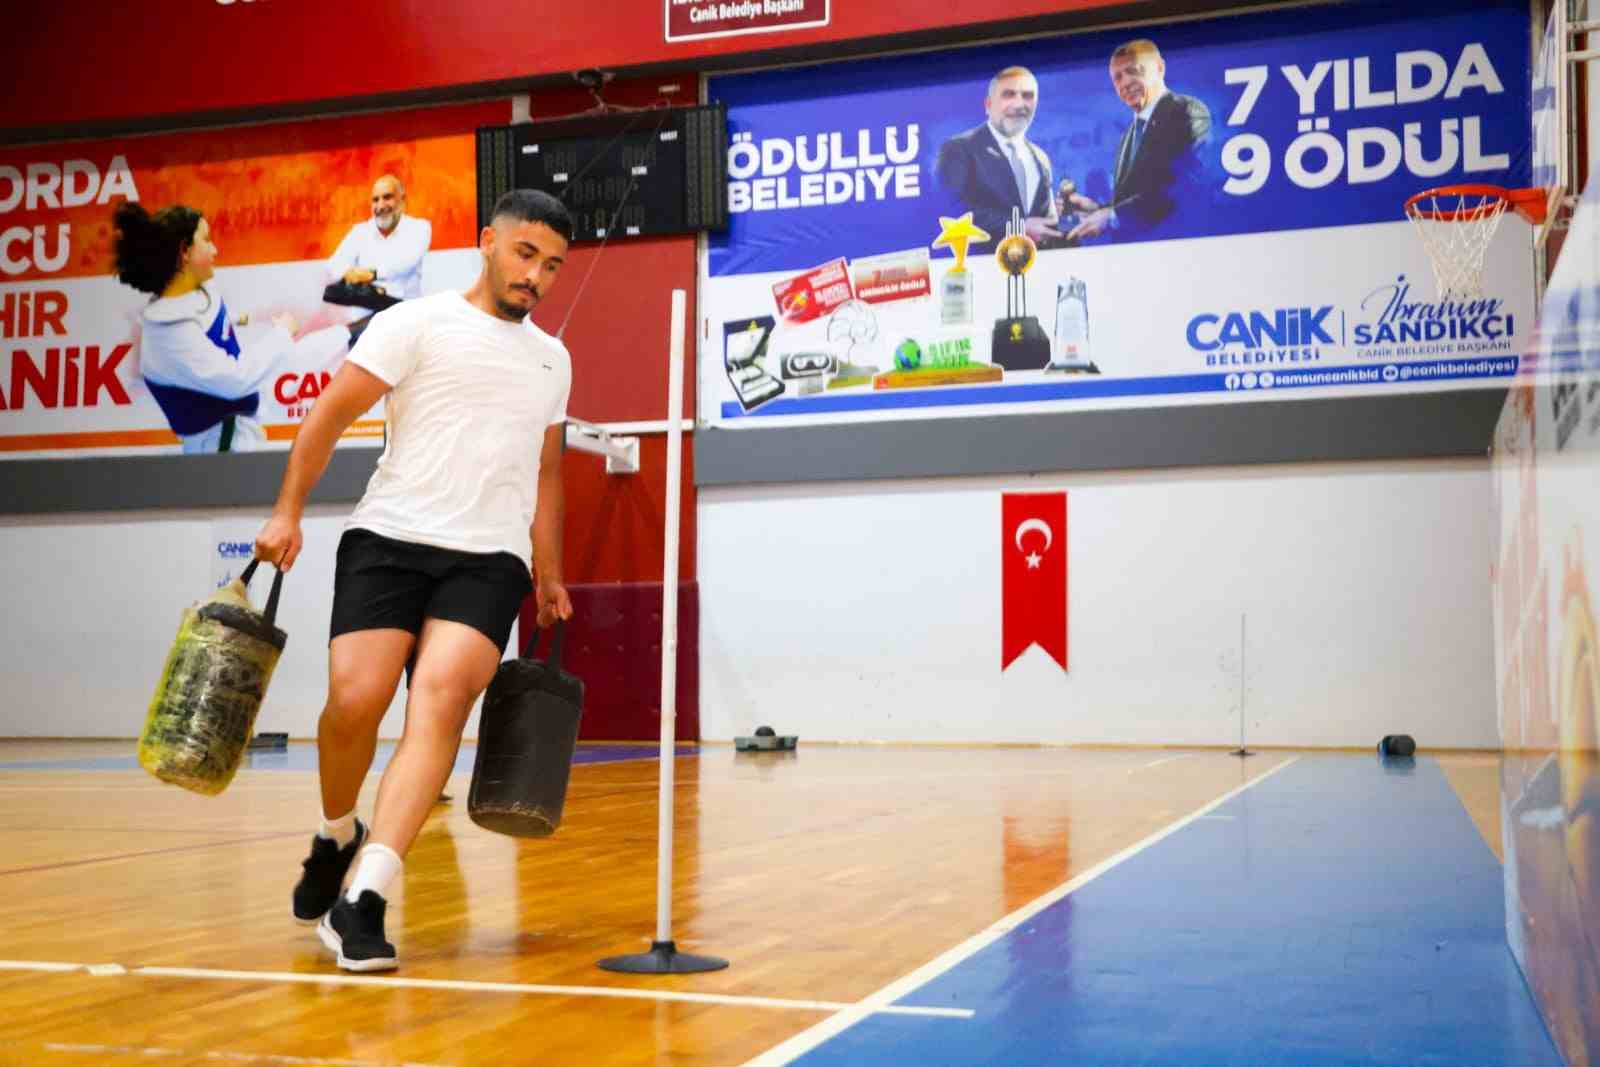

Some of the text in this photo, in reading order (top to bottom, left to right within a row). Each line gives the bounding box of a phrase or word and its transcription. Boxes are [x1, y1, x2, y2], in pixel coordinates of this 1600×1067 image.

[690, 6, 718, 23] Canik
[719, 2, 762, 19] Belediye
[1225, 43, 1504, 126] 7 YILDA
[728, 124, 919, 179] ÖDÜLLÜ
[1221, 116, 1510, 195] 9 ÖDÜL
[728, 164, 920, 213] BELEDİYE
[1186, 306, 1334, 351] CANİK
[1354, 314, 1514, 345] SANDIKÇI
[1206, 348, 1320, 366] BELEDİYESİ
